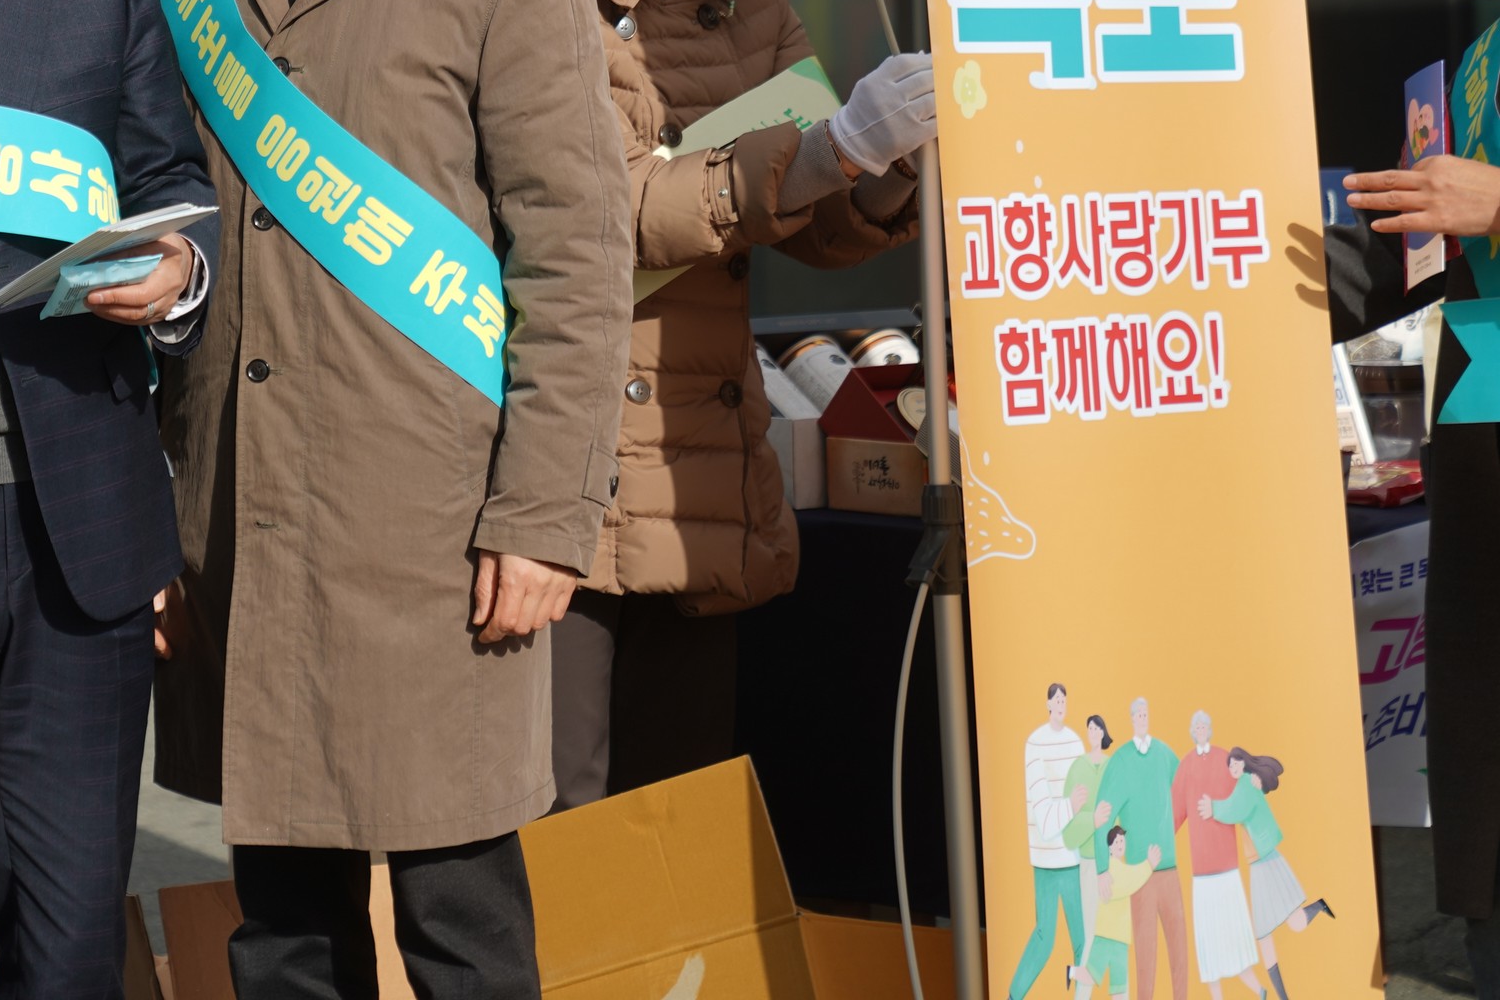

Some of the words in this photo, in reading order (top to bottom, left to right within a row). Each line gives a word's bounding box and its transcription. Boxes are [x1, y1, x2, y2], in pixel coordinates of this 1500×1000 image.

[256, 113, 414, 266] 응원해
[958, 190, 1270, 300] 고향사랑기부
[995, 312, 1231, 425] 함께해요!
[1360, 567, 1394, 596] 찾는
[1399, 562, 1414, 589] 큰
